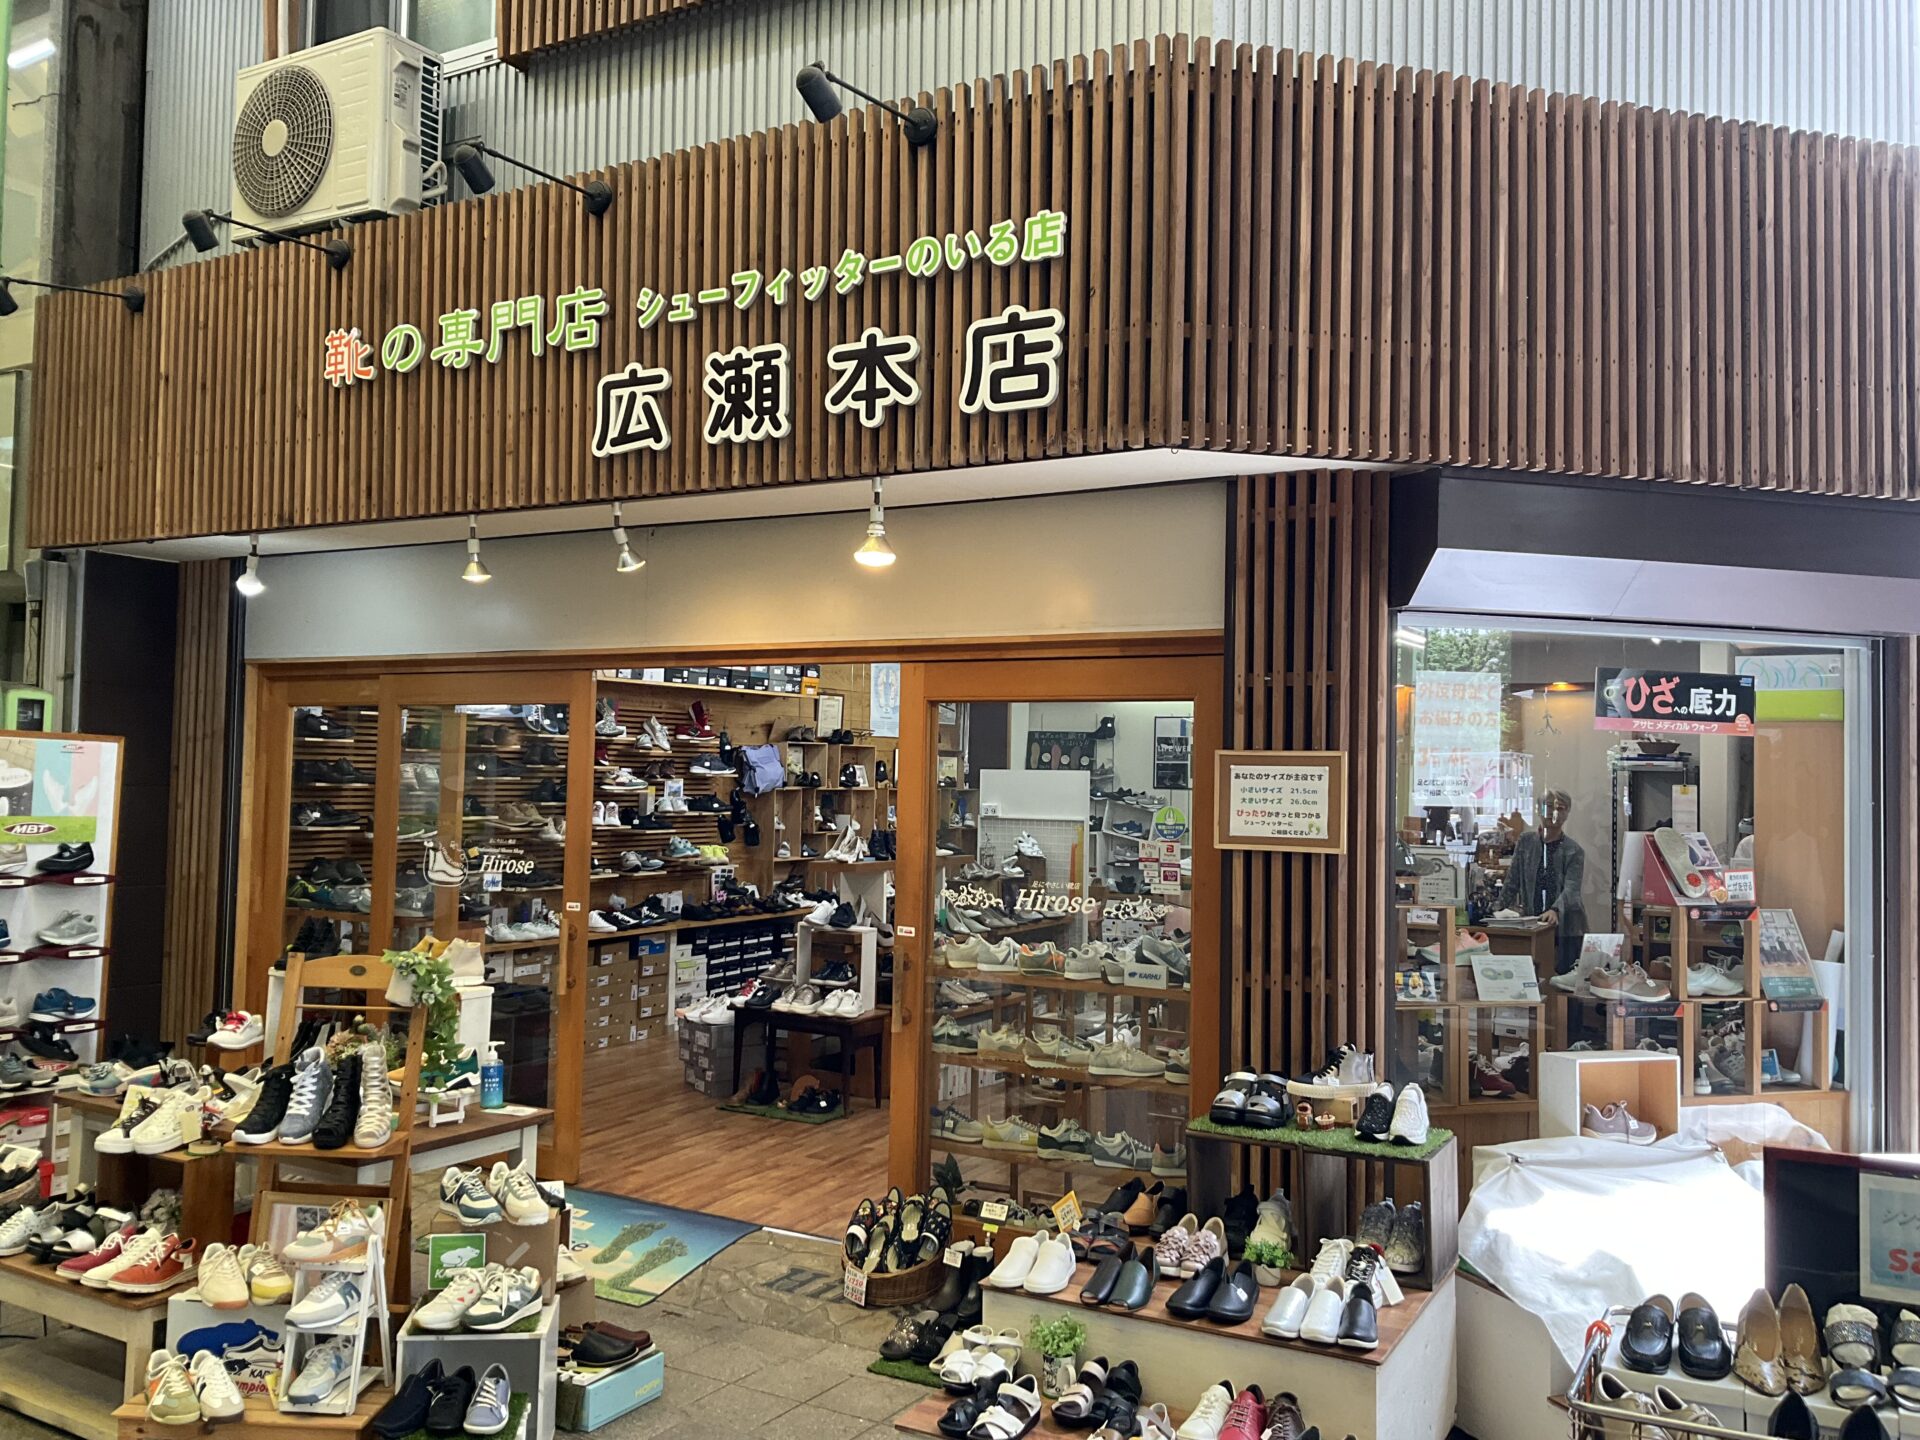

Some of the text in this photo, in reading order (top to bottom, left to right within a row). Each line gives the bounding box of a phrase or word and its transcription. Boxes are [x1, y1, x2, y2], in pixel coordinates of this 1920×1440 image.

[636, 208, 1067, 329] シューフィッターのいる店
[325, 286, 609, 387] 靴の専門店
[592, 304, 1066, 459] 広瀬本店
[1624, 676, 1737, 717] ひざへの底力
[1632, 720, 1719, 732] アサヒ メディカル ウォーク
[1234, 772, 1324, 782] あなたのサイズが主役です
[1240, 786, 1318, 795] 小さいサイズ 21.5cm
[1240, 797, 1318, 806] 大きいサイズ 26.0cm
[1236, 809, 1321, 819] ぴったりがきっと見つかる
[11, 824, 48, 834] MBT
[480, 855, 534, 875] Hirose
[1013, 888, 1096, 914] Hirose
[1139, 972, 1161, 980] KARHU
